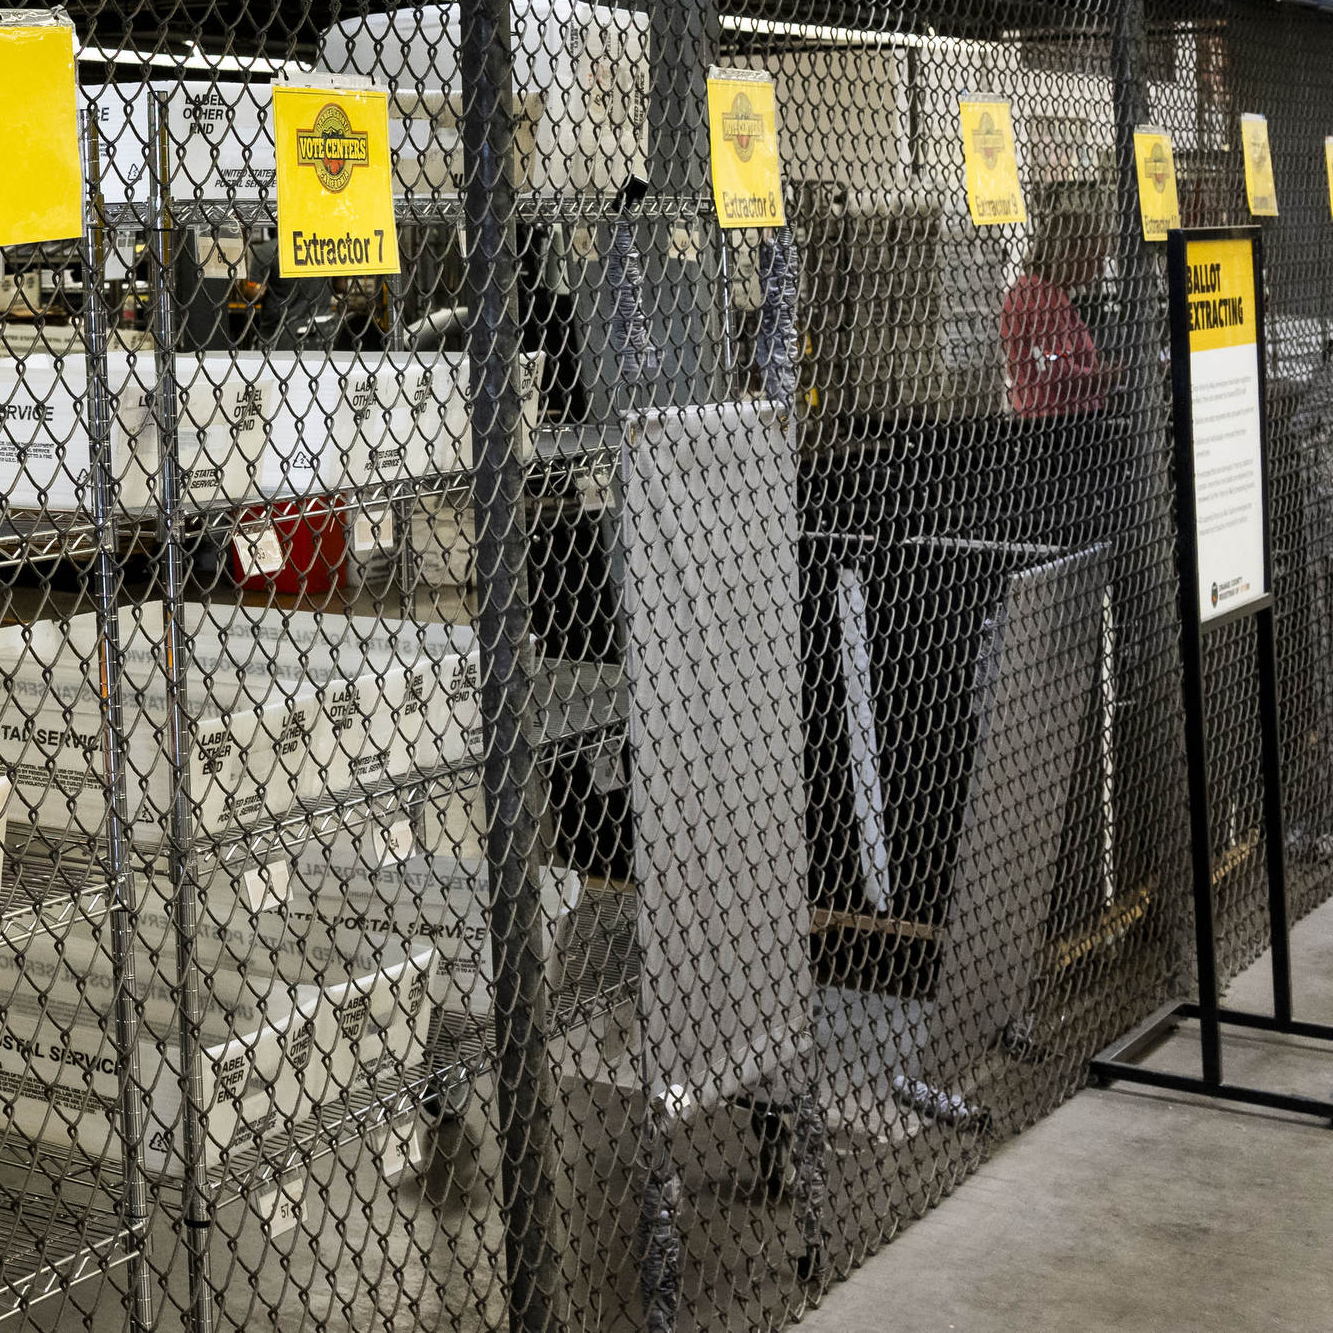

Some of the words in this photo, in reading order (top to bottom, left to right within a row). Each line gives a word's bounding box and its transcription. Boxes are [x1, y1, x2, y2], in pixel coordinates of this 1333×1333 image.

[299, 137, 325, 159] VOTE
[325, 137, 367, 161] CENTERS
[722, 191, 767, 219] Extractor
[768, 191, 777, 218] 8
[292, 231, 371, 266] Extractor
[374, 230, 384, 263] 7
[1186, 263, 1221, 295] BALLOT
[1188, 296, 1244, 332] EXTRACTING
